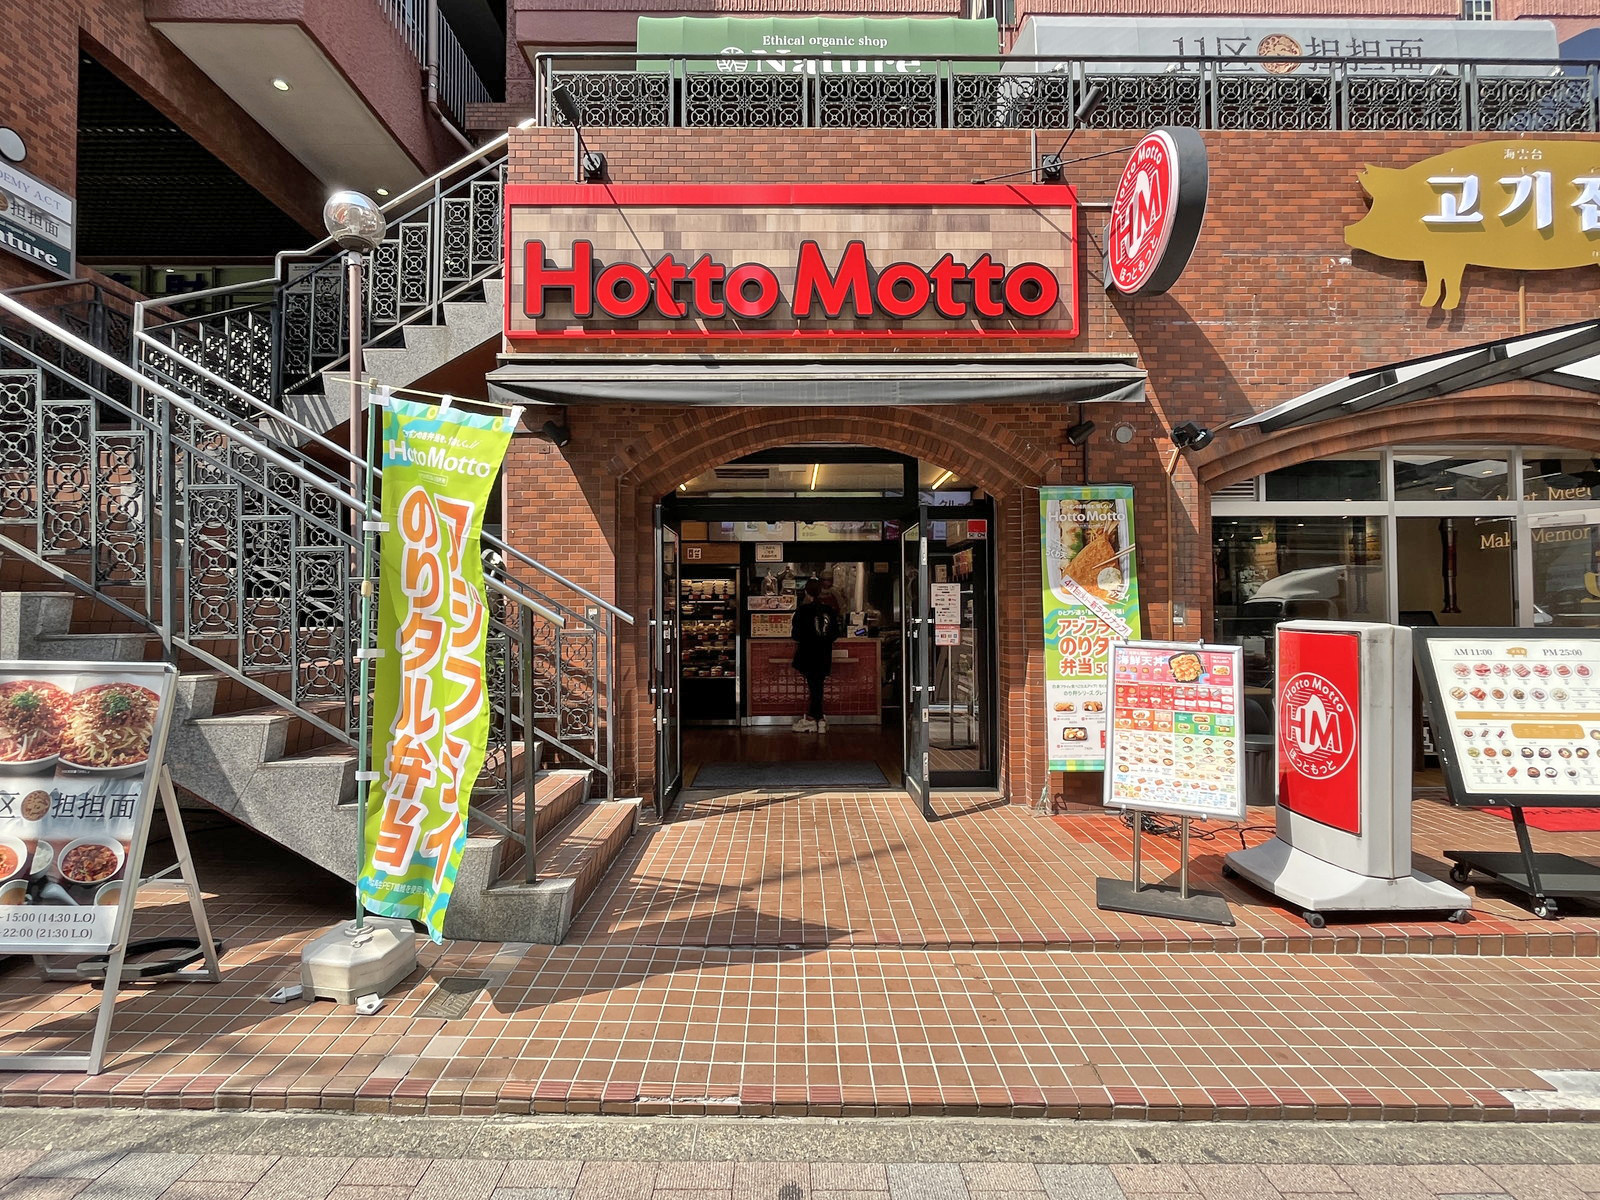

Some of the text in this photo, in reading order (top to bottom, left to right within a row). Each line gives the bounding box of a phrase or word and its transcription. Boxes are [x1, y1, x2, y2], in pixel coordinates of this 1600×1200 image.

[763, 35, 888, 48] Ethical organic shop
[1305, 36, 1424, 73] 担担面
[10, 196, 60, 238] 担担面
[523, 239, 1060, 319] Hotto Motto
[389, 439, 426, 467] Hoto
[1480, 532, 1510, 549] Mak
[1058, 616, 1125, 636] アジフラ
[1060, 636, 1122, 657] のりタ
[1061, 658, 1094, 676] 弁当
[373, 487, 439, 875] のりタル弁当
[1289, 748, 1336, 775] ほっともっと
[51, 791, 139, 820] 担担面
